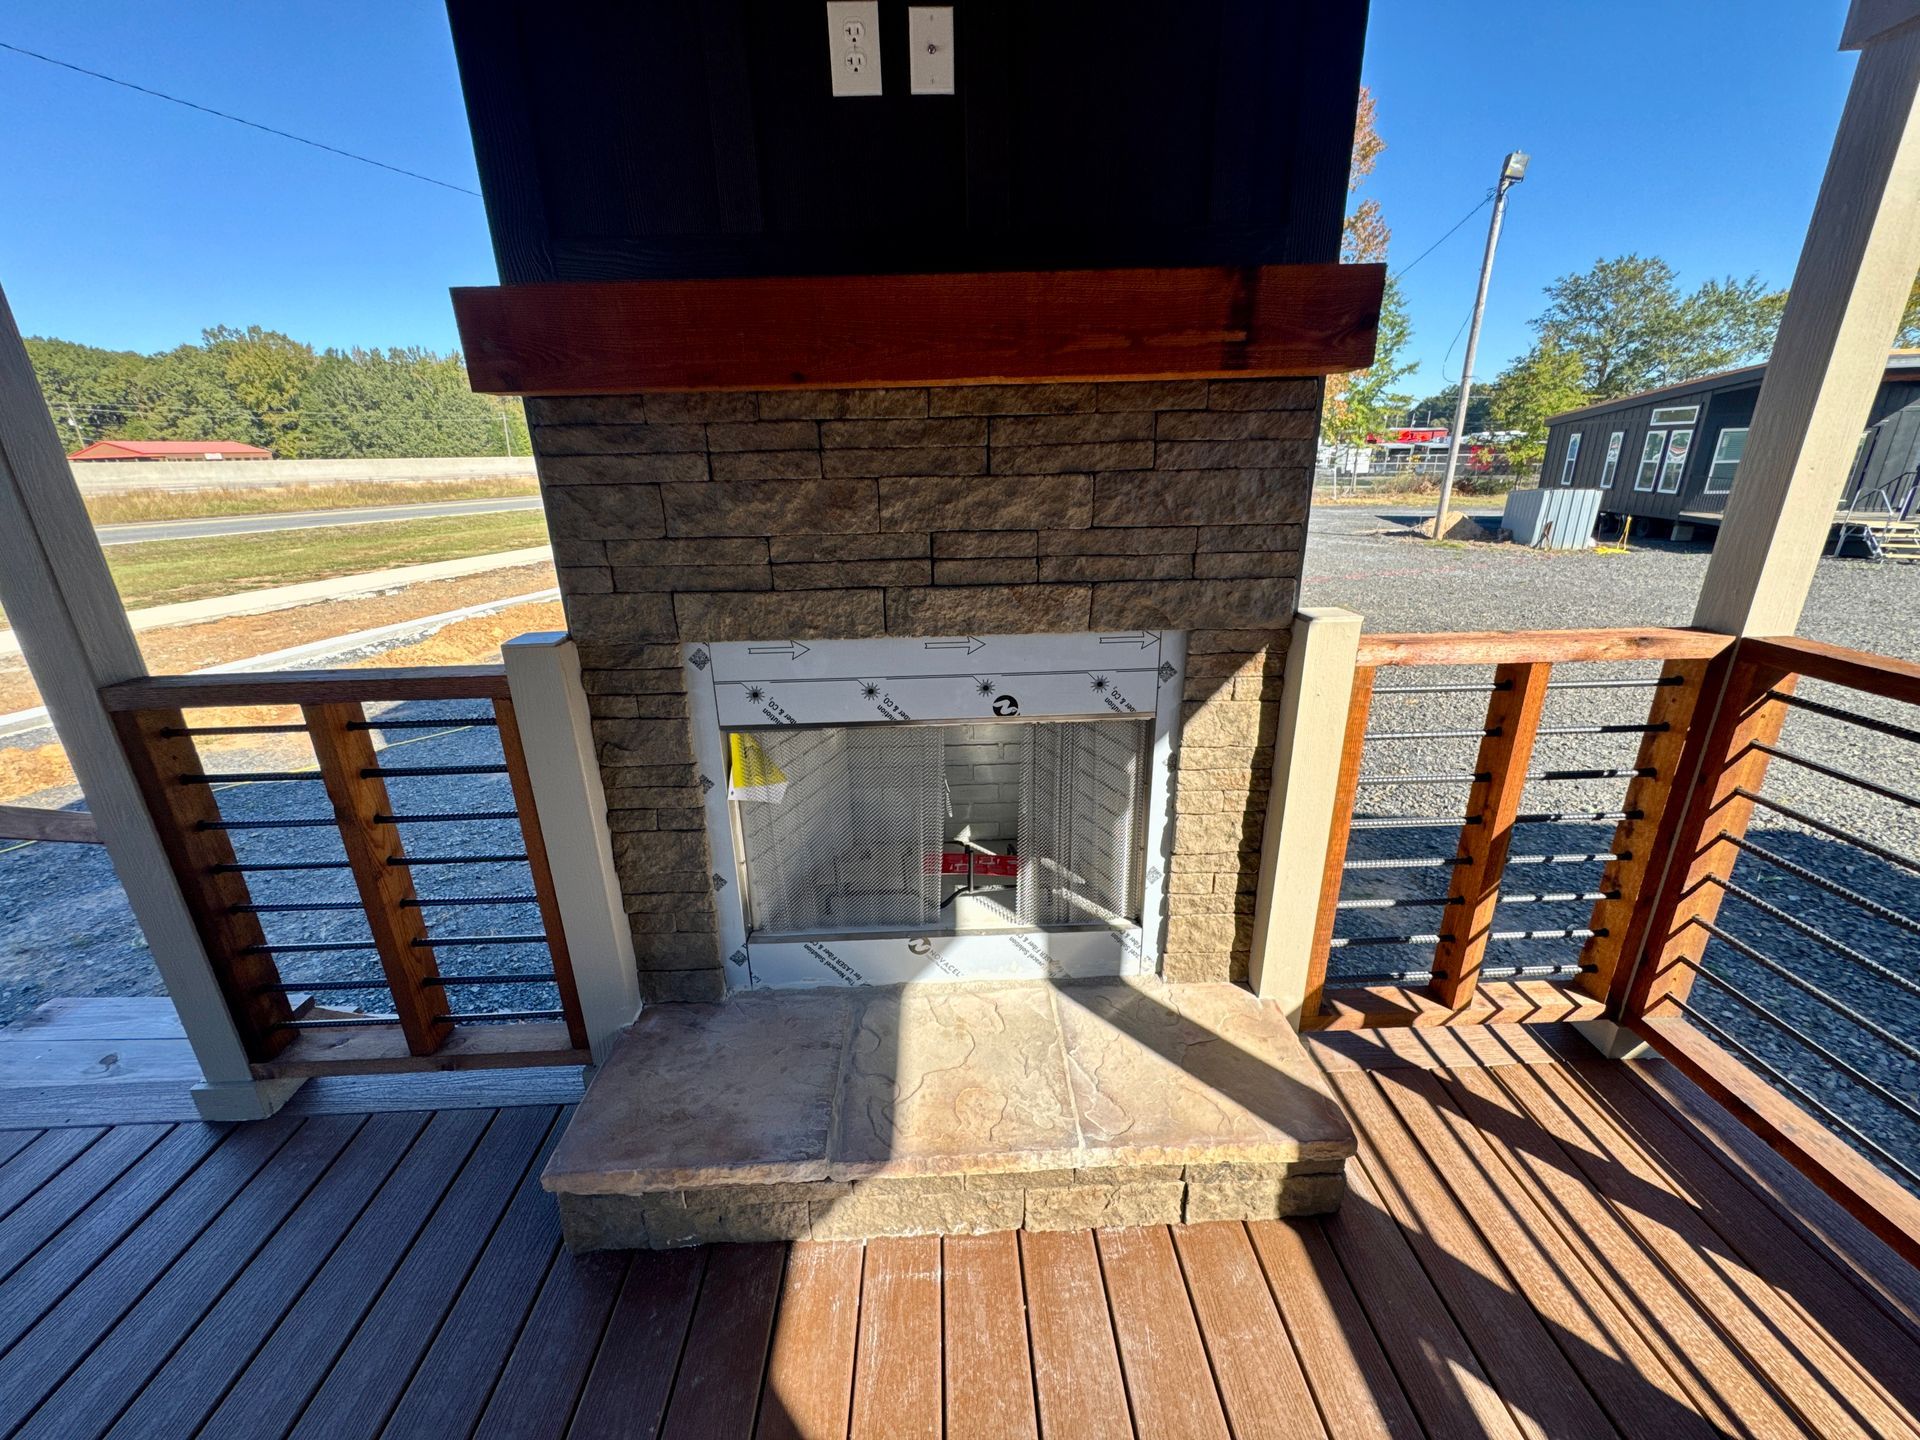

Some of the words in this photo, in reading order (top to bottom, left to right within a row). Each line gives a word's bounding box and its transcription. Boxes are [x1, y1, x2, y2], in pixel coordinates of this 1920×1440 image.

[891, 704, 899, 712] &
[1118, 697, 1126, 705] &
[777, 708, 785, 716] &
[1007, 936, 1029, 955] Solution
[1026, 940, 1041, 954] Fiber
[802, 943, 826, 963] Solution
[821, 947, 837, 961] Fiber
[824, 960, 846, 979] Novacel
[835, 958, 854, 974] LASER
[928, 949, 962, 977] NOVACEL
[852, 971, 862, 980] for
